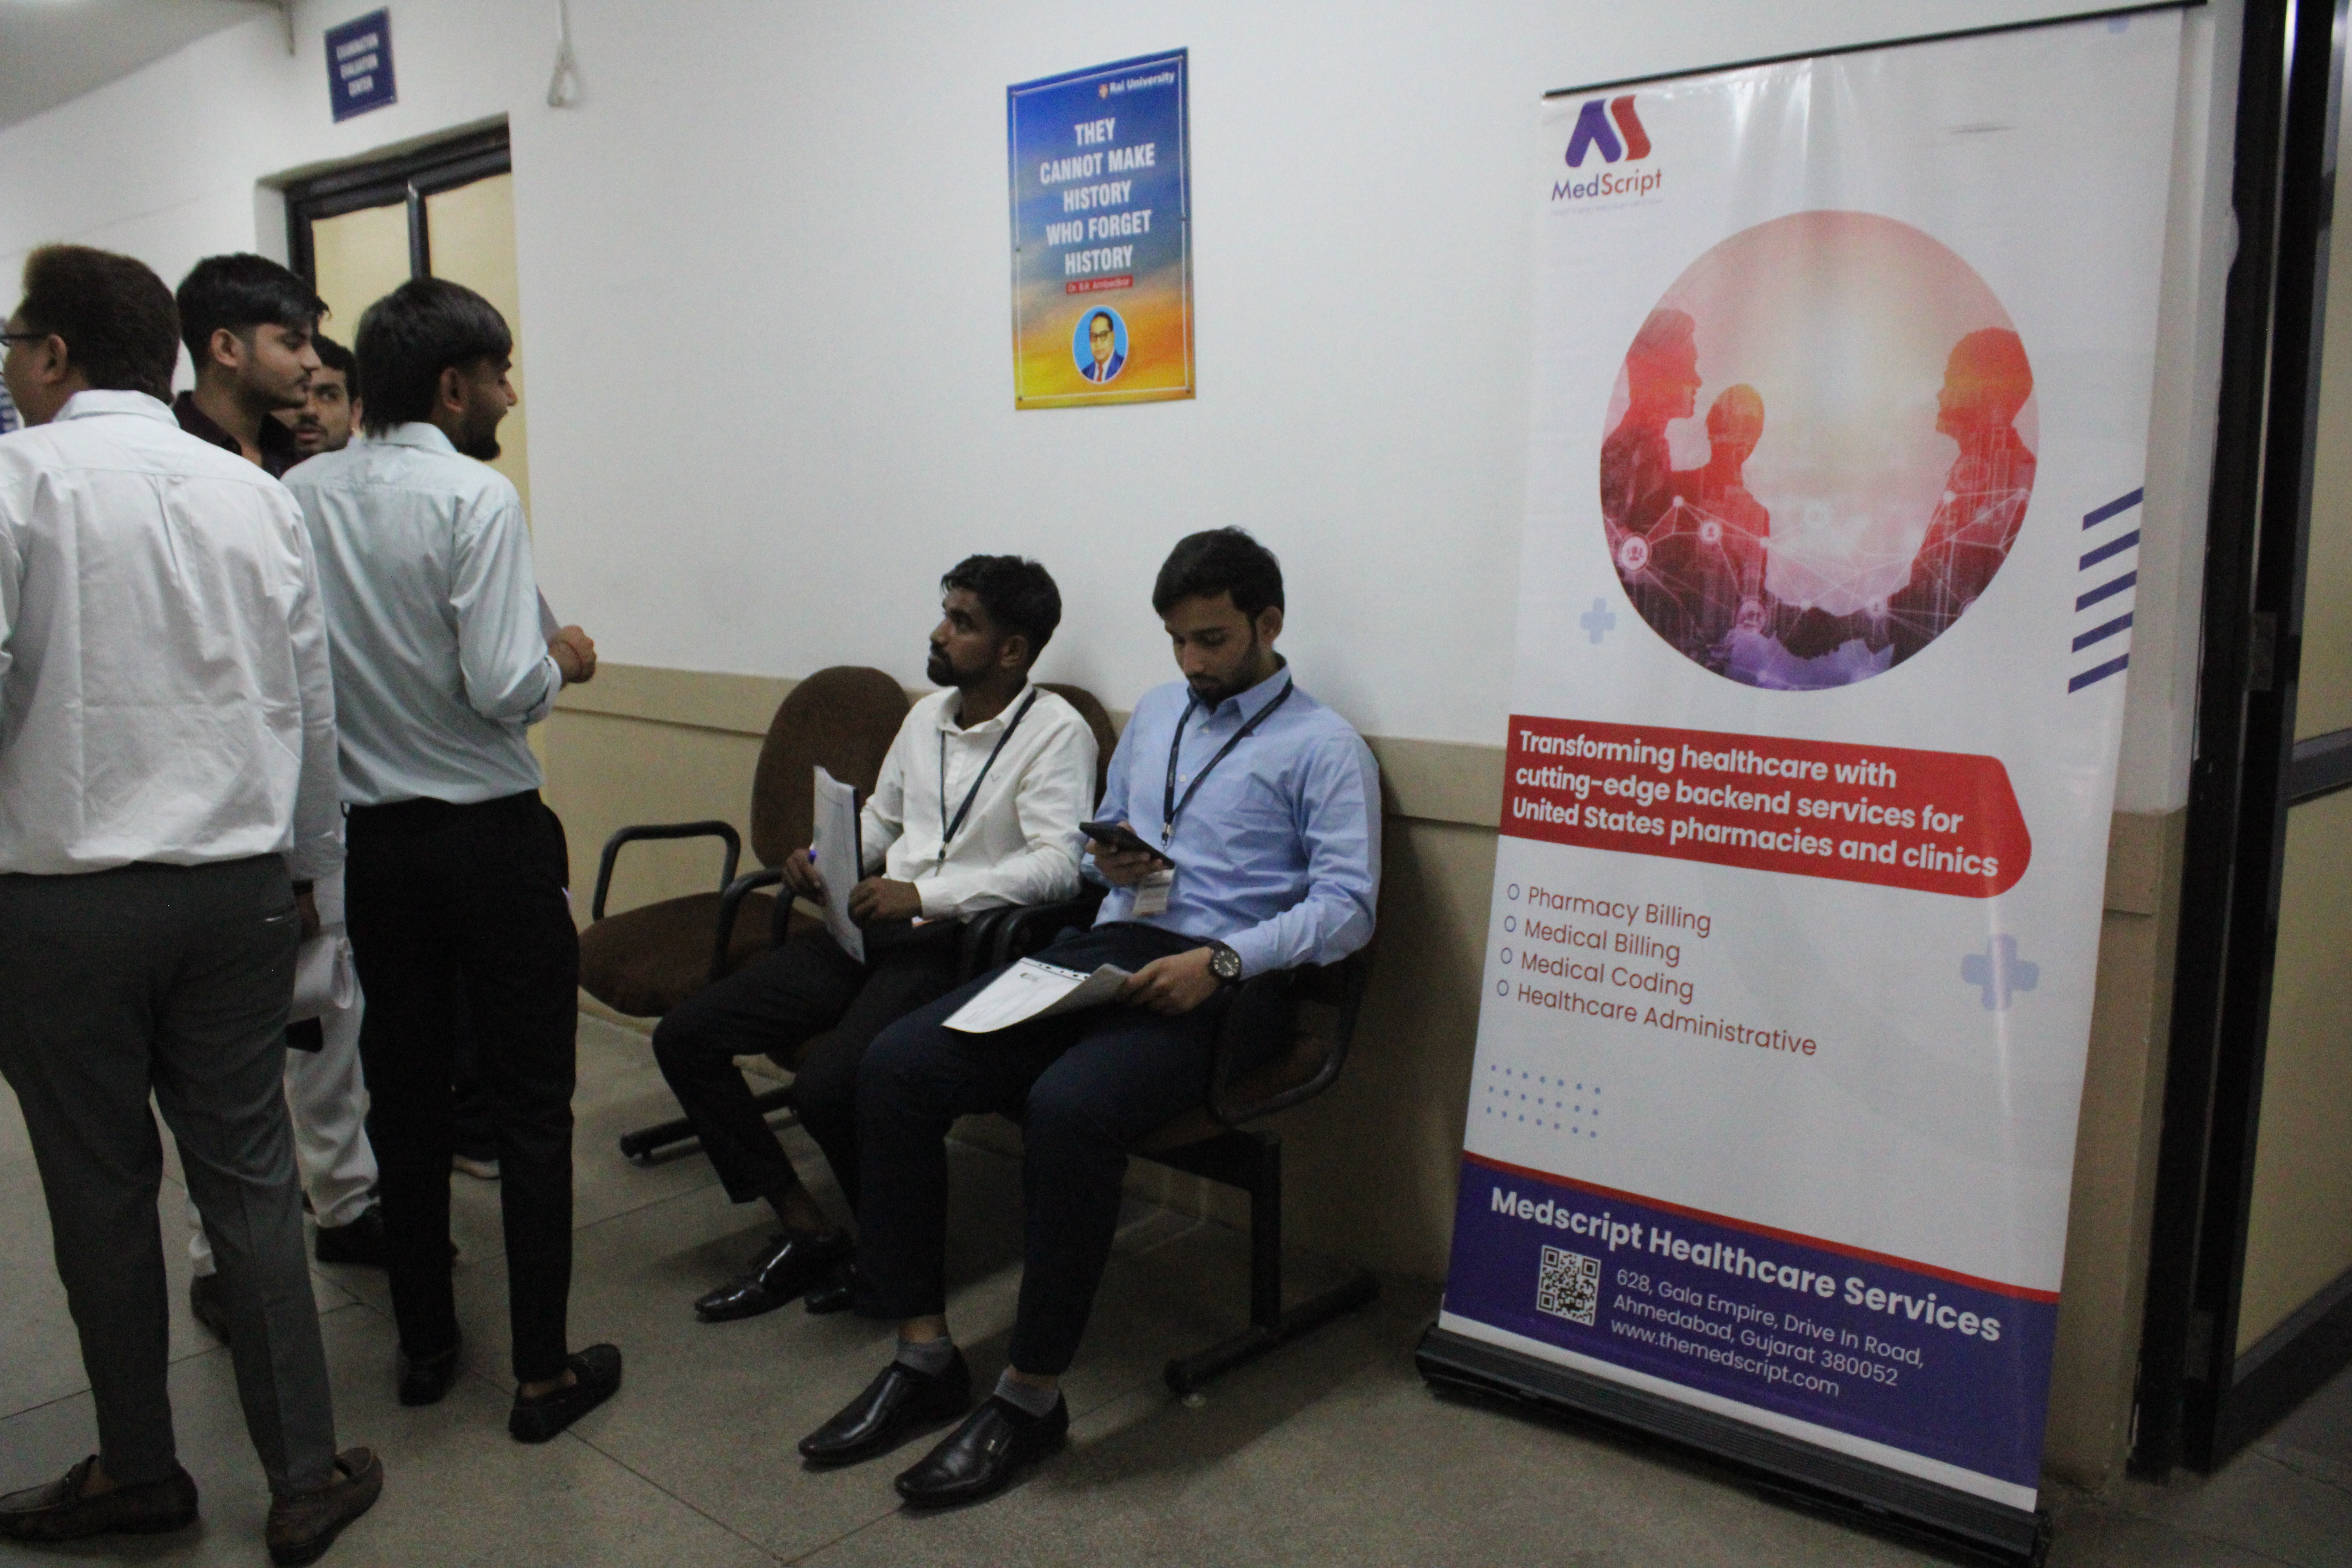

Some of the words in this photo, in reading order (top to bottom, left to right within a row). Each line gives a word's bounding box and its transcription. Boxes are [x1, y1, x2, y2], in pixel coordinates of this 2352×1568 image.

[1127, 72, 1175, 89] University
[1074, 118, 1115, 146] THEY
[1040, 152, 1103, 184] CANNOT
[1108, 143, 1155, 172] MAKE
[1552, 169, 1662, 200] MedScript
[1063, 180, 1131, 212] HISTORY
[1046, 220, 1083, 246] WHO
[1088, 209, 1152, 239] FORGET
[1065, 245, 1133, 274] HISTORY
[1520, 730, 1675, 773] Transforming
[1681, 744, 1828, 780] healthcare
[1835, 759, 1896, 787] with
[1516, 765, 1670, 806] cutting-edge
[1676, 780, 1791, 814] backend
[1797, 797, 1915, 828] services
[1922, 804, 1964, 833] for
[1513, 797, 1579, 825] United
[1584, 806, 1664, 835] States
[1670, 817, 1833, 856] pharmacies
[1839, 840, 1897, 864] and
[1903, 843, 1999, 877] clinics
[1528, 886, 1639, 926] Pharmacy
[1646, 903, 1711, 938] Billing
[1524, 918, 1607, 951] Medical
[1615, 933, 1681, 967] Billing
[1521, 951, 1604, 983] Medical
[1612, 967, 1694, 1005] Coding
[1517, 983, 1637, 1022] Healthcare
[1644, 1007, 1817, 1055] Administrative
[1492, 1187, 1642, 1251] Medscript
[1649, 1227, 1835, 1298] Healthcare
[1844, 1277, 2000, 1341] Services
[1613, 1294, 1734, 1344] Ahmedabad,
[1740, 1329, 1815, 1363] Gujarat
[1821, 1350, 1898, 1386] 380052
[1617, 1269, 1653, 1296] 628,
[1658, 1281, 1702, 1307] Gala
[1708, 1294, 1778, 1329] Empire,
[1784, 1314, 1835, 1342] Drive
[1840, 1330, 1858, 1349] In
[1865, 1336, 1924, 1368] Road,
[1612, 1319, 1839, 1396] www.themedscript.com
